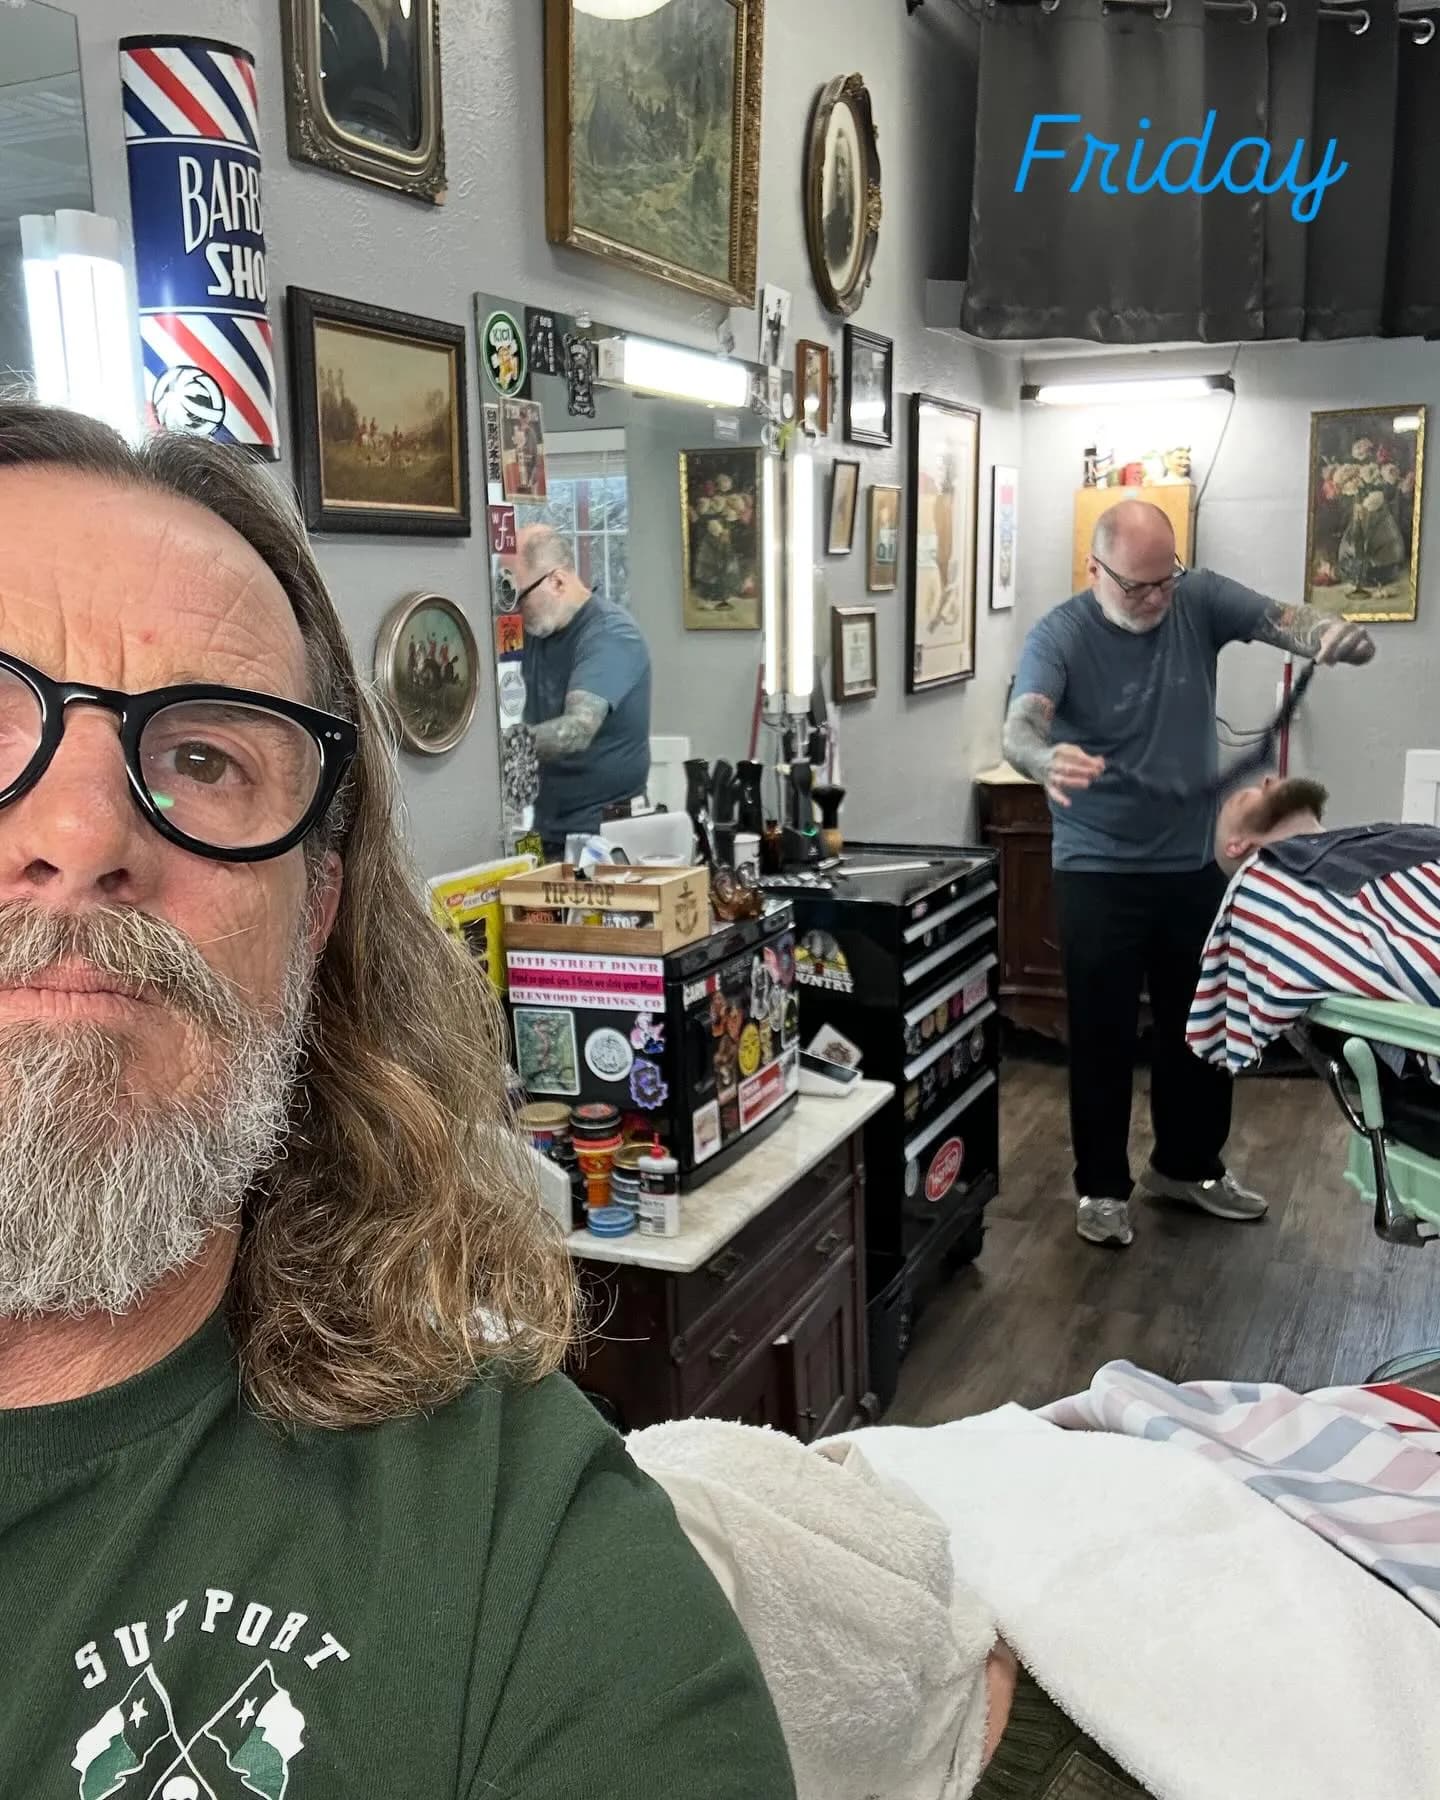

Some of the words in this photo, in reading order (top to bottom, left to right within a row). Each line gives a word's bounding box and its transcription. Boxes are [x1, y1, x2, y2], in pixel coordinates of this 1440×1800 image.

[178, 156, 264, 255] BARB
[205, 241, 267, 303] SHO
[541, 881, 569, 905] TIP
[584, 883, 616, 906] TOP
[510, 955, 545, 967] 19TH
[549, 957, 607, 970] STREET
[611, 960, 659, 973] DINER
[512, 990, 578, 1003] GLENWOOD
[581, 994, 641, 1008] SPRINGS,
[644, 998, 662, 1009] CO
[74, 1588, 351, 1690] SUPPORT
